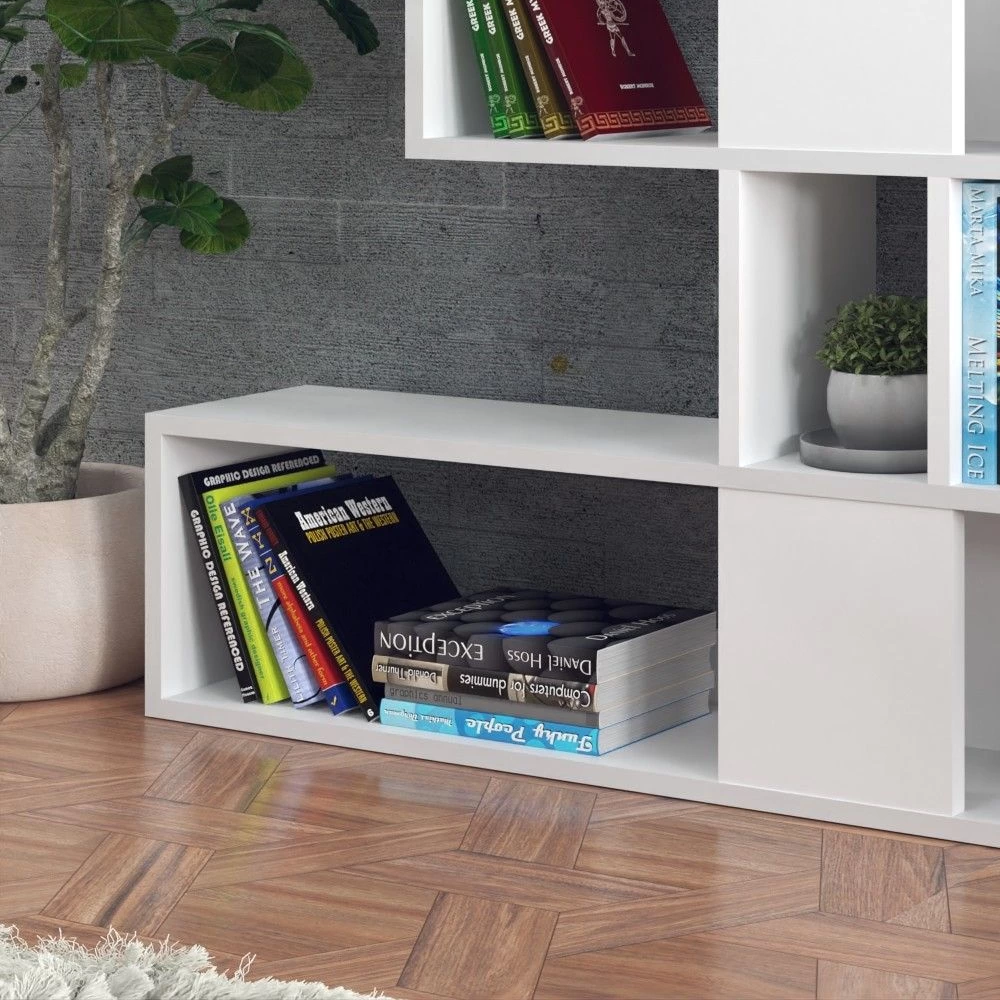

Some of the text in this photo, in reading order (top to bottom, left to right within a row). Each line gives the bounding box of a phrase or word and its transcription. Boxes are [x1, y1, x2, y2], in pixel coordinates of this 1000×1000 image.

[466, 0, 479, 31] GREEK
[483, 2, 496, 34] GREEK
[509, 8, 524, 40] GREEK
[536, 13, 553, 44] GREEK
[970, 189, 985, 297] MARTA MIKA
[967, 337, 988, 479] MELTING ICE
[203, 455, 320, 487] GRAPHIC DESIGN REFERENCED
[294, 505, 351, 531] American
[344, 496, 393, 519] Western
[305, 529, 329, 544] POLISH
[325, 523, 349, 539] POSTER
[345, 521, 360, 534] ART
[361, 517, 375, 529] THE
[371, 511, 400, 527] WESTERN
[224, 502, 251, 561] WAVE
[190, 509, 244, 672] GRAPHIC DESIGN REFERENCED
[248, 567, 270, 610] THE
[278, 550, 315, 612] American Western
[307, 648, 319, 668] other
[315, 618, 331, 638] POLISH
[324, 635, 341, 656] POSTER
[334, 653, 347, 667] ART
[343, 667, 355, 681] THE
[349, 677, 368, 704] WESTERN
[375, 664, 438, 684] Donald Thurner
[390, 687, 462, 706] graphics annual
[460, 673, 591, 707] Computers for dummies
[465, 718, 593, 752] Funky People
